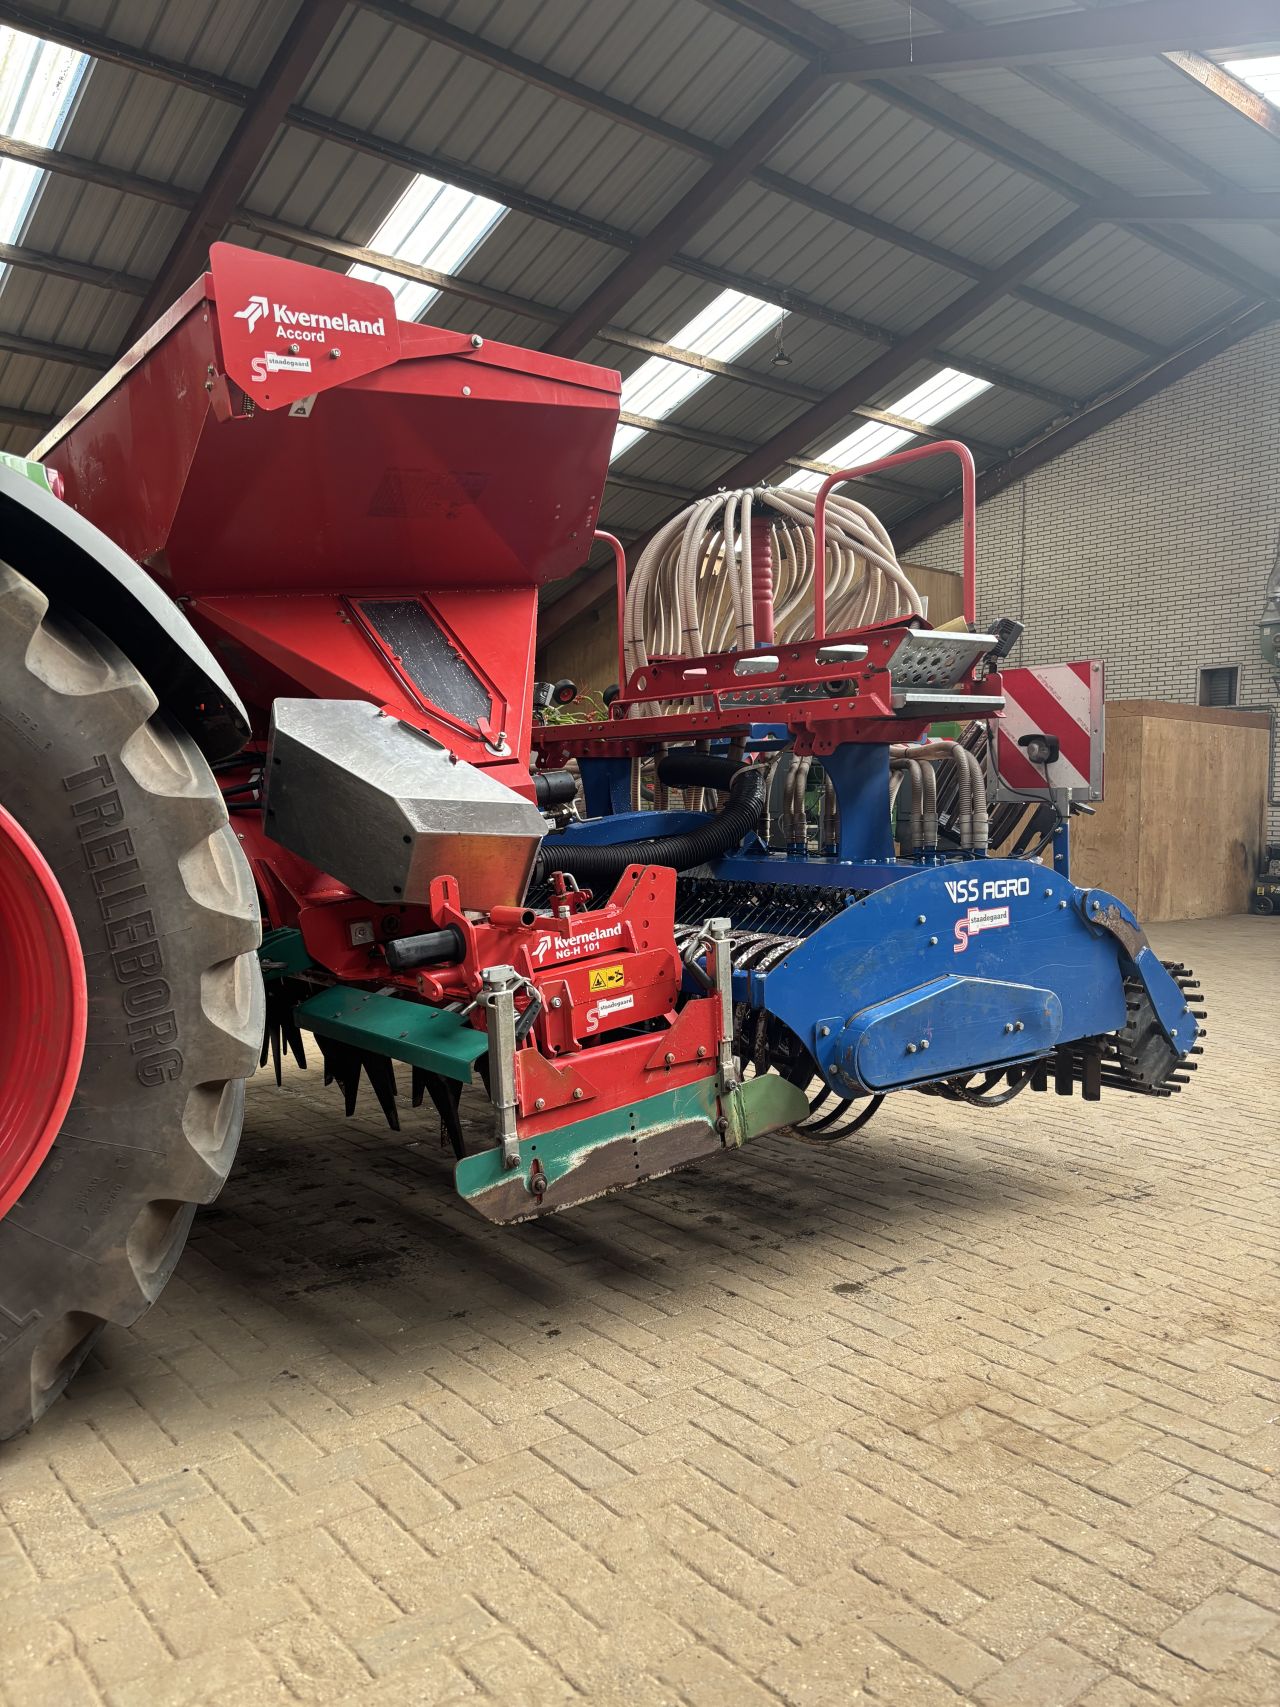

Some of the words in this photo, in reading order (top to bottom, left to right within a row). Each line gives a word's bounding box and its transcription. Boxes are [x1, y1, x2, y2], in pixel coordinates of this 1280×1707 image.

[272, 303, 385, 336] Kverneland
[276, 326, 325, 343] Accord
[944, 878, 979, 904] VSS
[982, 877, 1030, 900] AGRO
[63, 752, 184, 1088] TRELLEBORG
[554, 922, 622, 949] Kverneland
[555, 946, 581, 960] NG-H
[583, 941, 600, 953] 101
